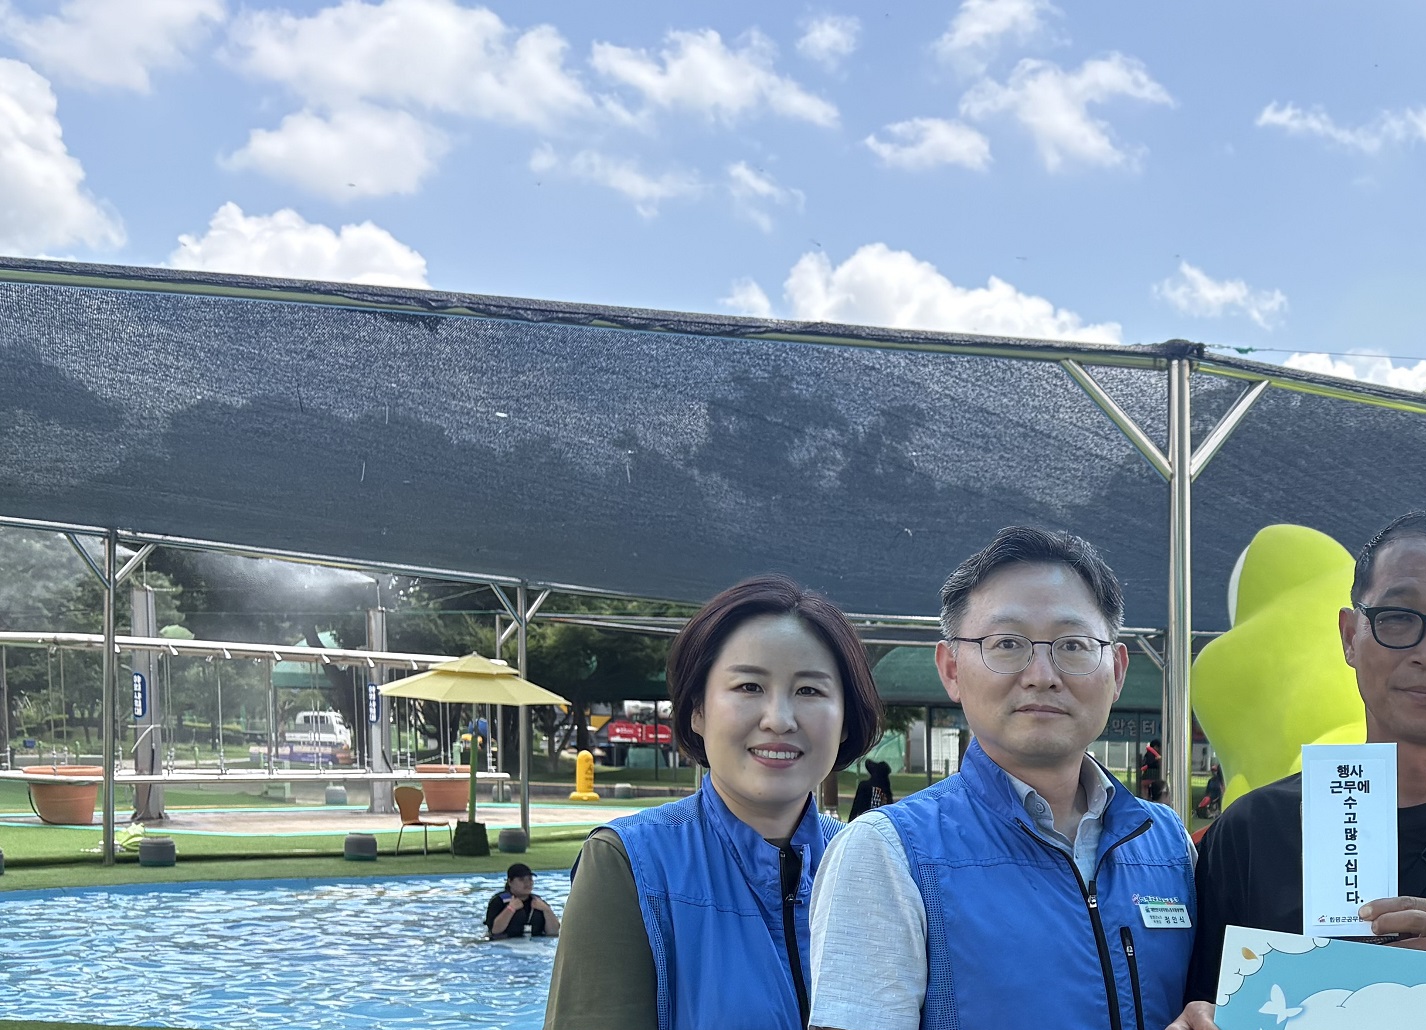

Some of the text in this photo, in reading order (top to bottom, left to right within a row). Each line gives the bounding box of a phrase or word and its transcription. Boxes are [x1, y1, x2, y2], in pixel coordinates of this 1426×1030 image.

[1102, 719, 1157, 737] 막쉼터
[1336, 764, 1364, 778] 행사
[1329, 780, 1371, 794] 근무에
